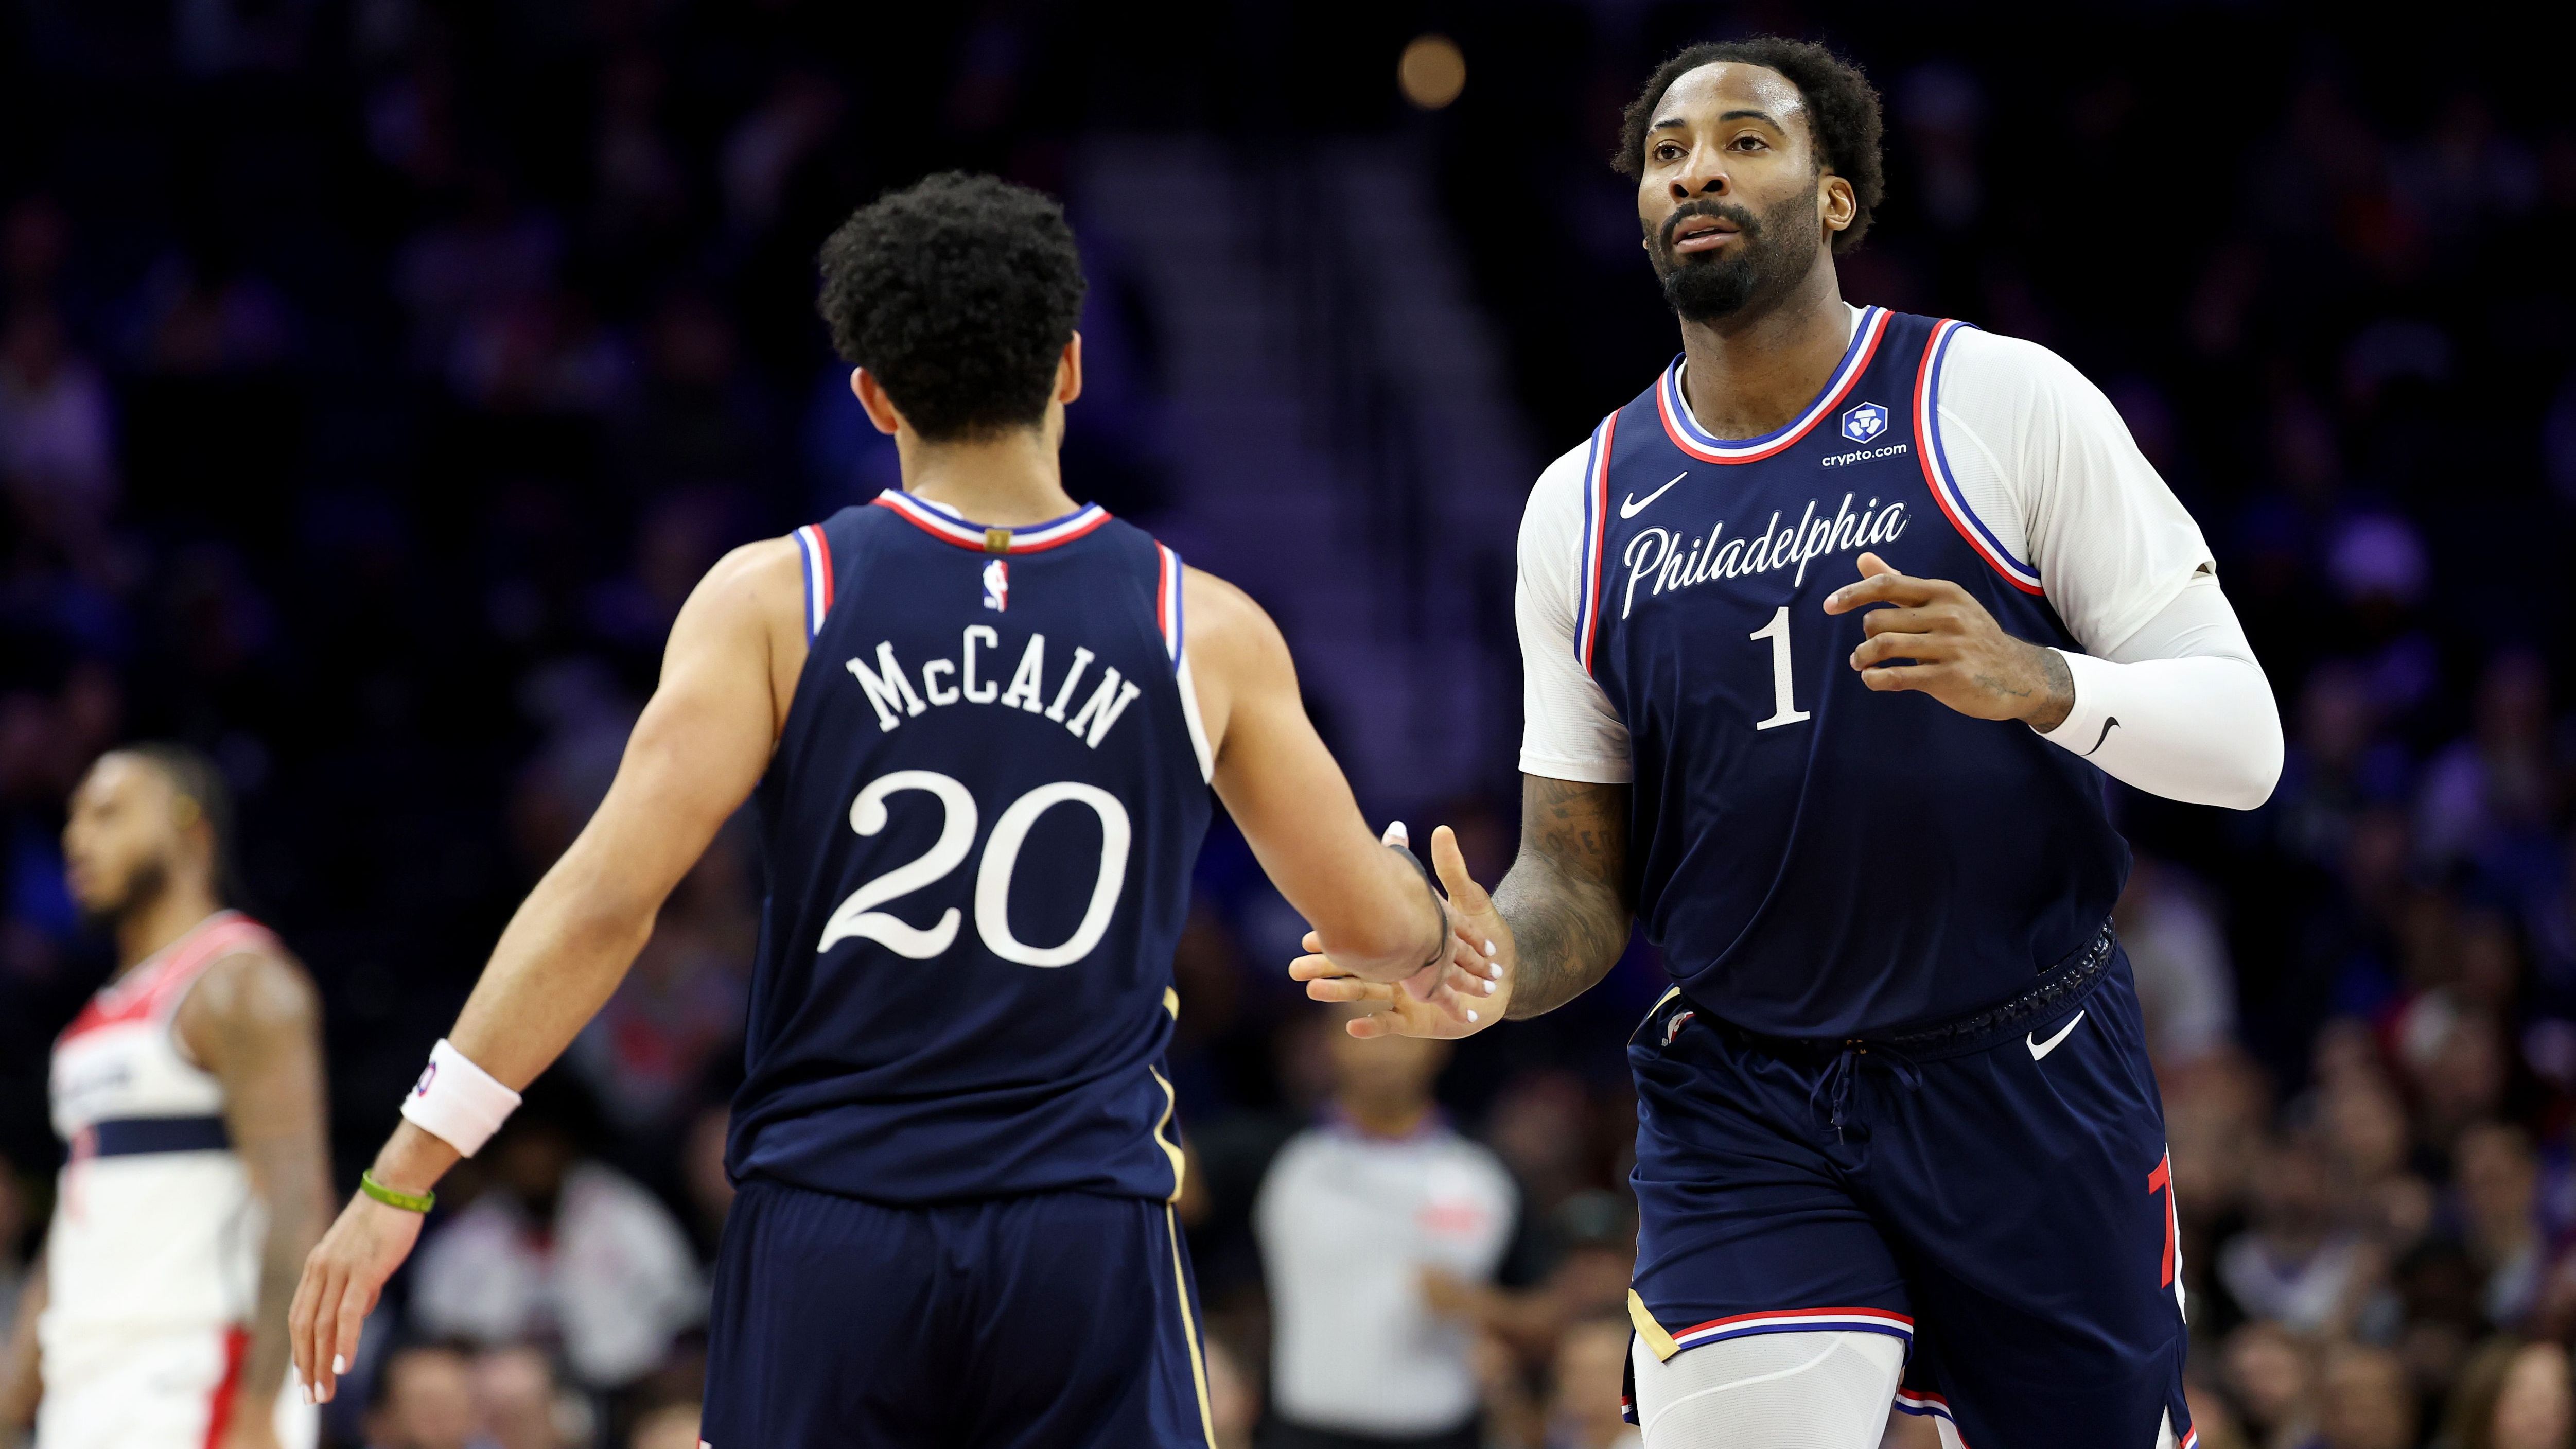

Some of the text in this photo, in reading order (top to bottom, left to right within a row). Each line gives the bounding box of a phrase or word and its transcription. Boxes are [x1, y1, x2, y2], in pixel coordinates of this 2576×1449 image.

[1821, 444, 1907, 467] crypto.com
[1621, 493, 1907, 620] Philadelphia
[845, 624, 1141, 749] McCAIN
[1749, 606, 1811, 731] 1
[817, 770, 1131, 968] 20
